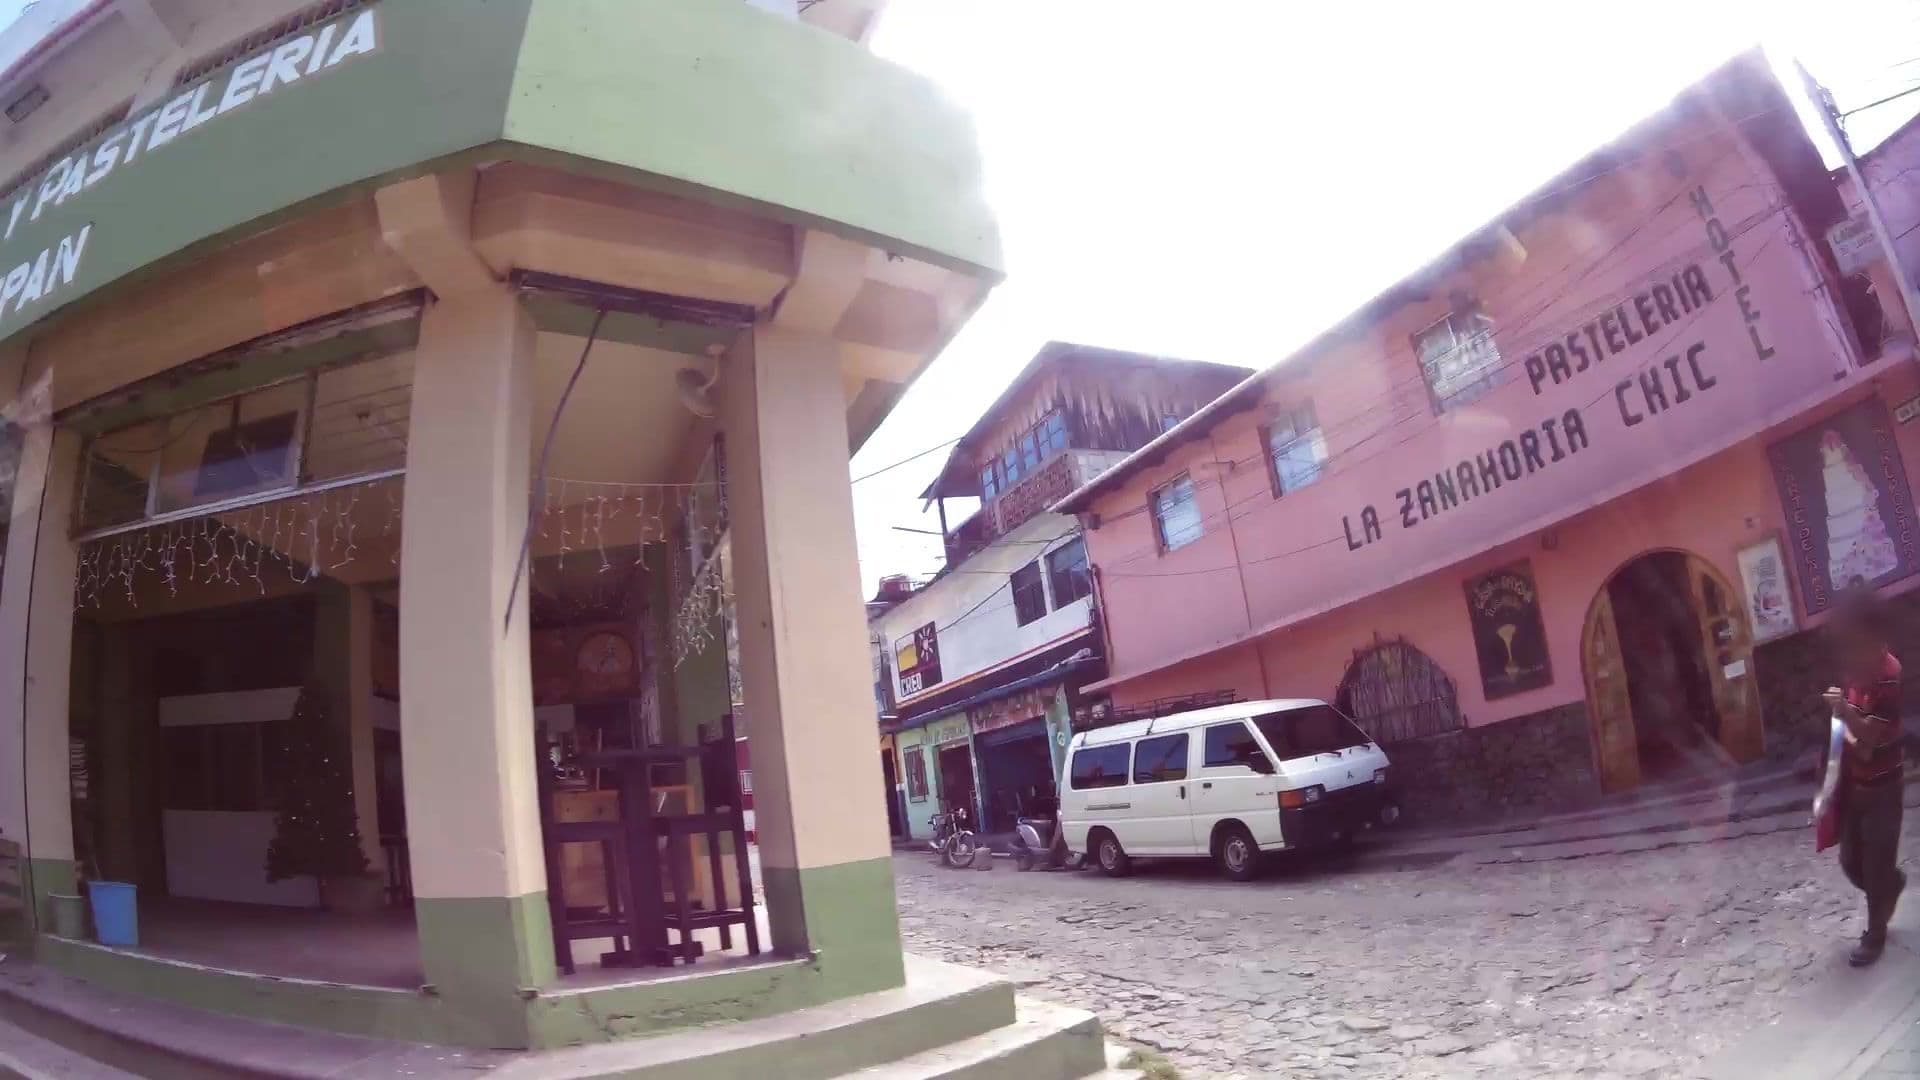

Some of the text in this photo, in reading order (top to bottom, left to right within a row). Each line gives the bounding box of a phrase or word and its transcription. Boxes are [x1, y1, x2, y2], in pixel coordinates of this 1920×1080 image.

[4, 9, 377, 241] Y PASTELERIA
[0, 223, 92, 326] PAN
[1525, 264, 1714, 396] PASTELERIA
[1688, 184, 1776, 361] HOTEL
[1342, 341, 1717, 552] LA ZANAHORIA CHIC
